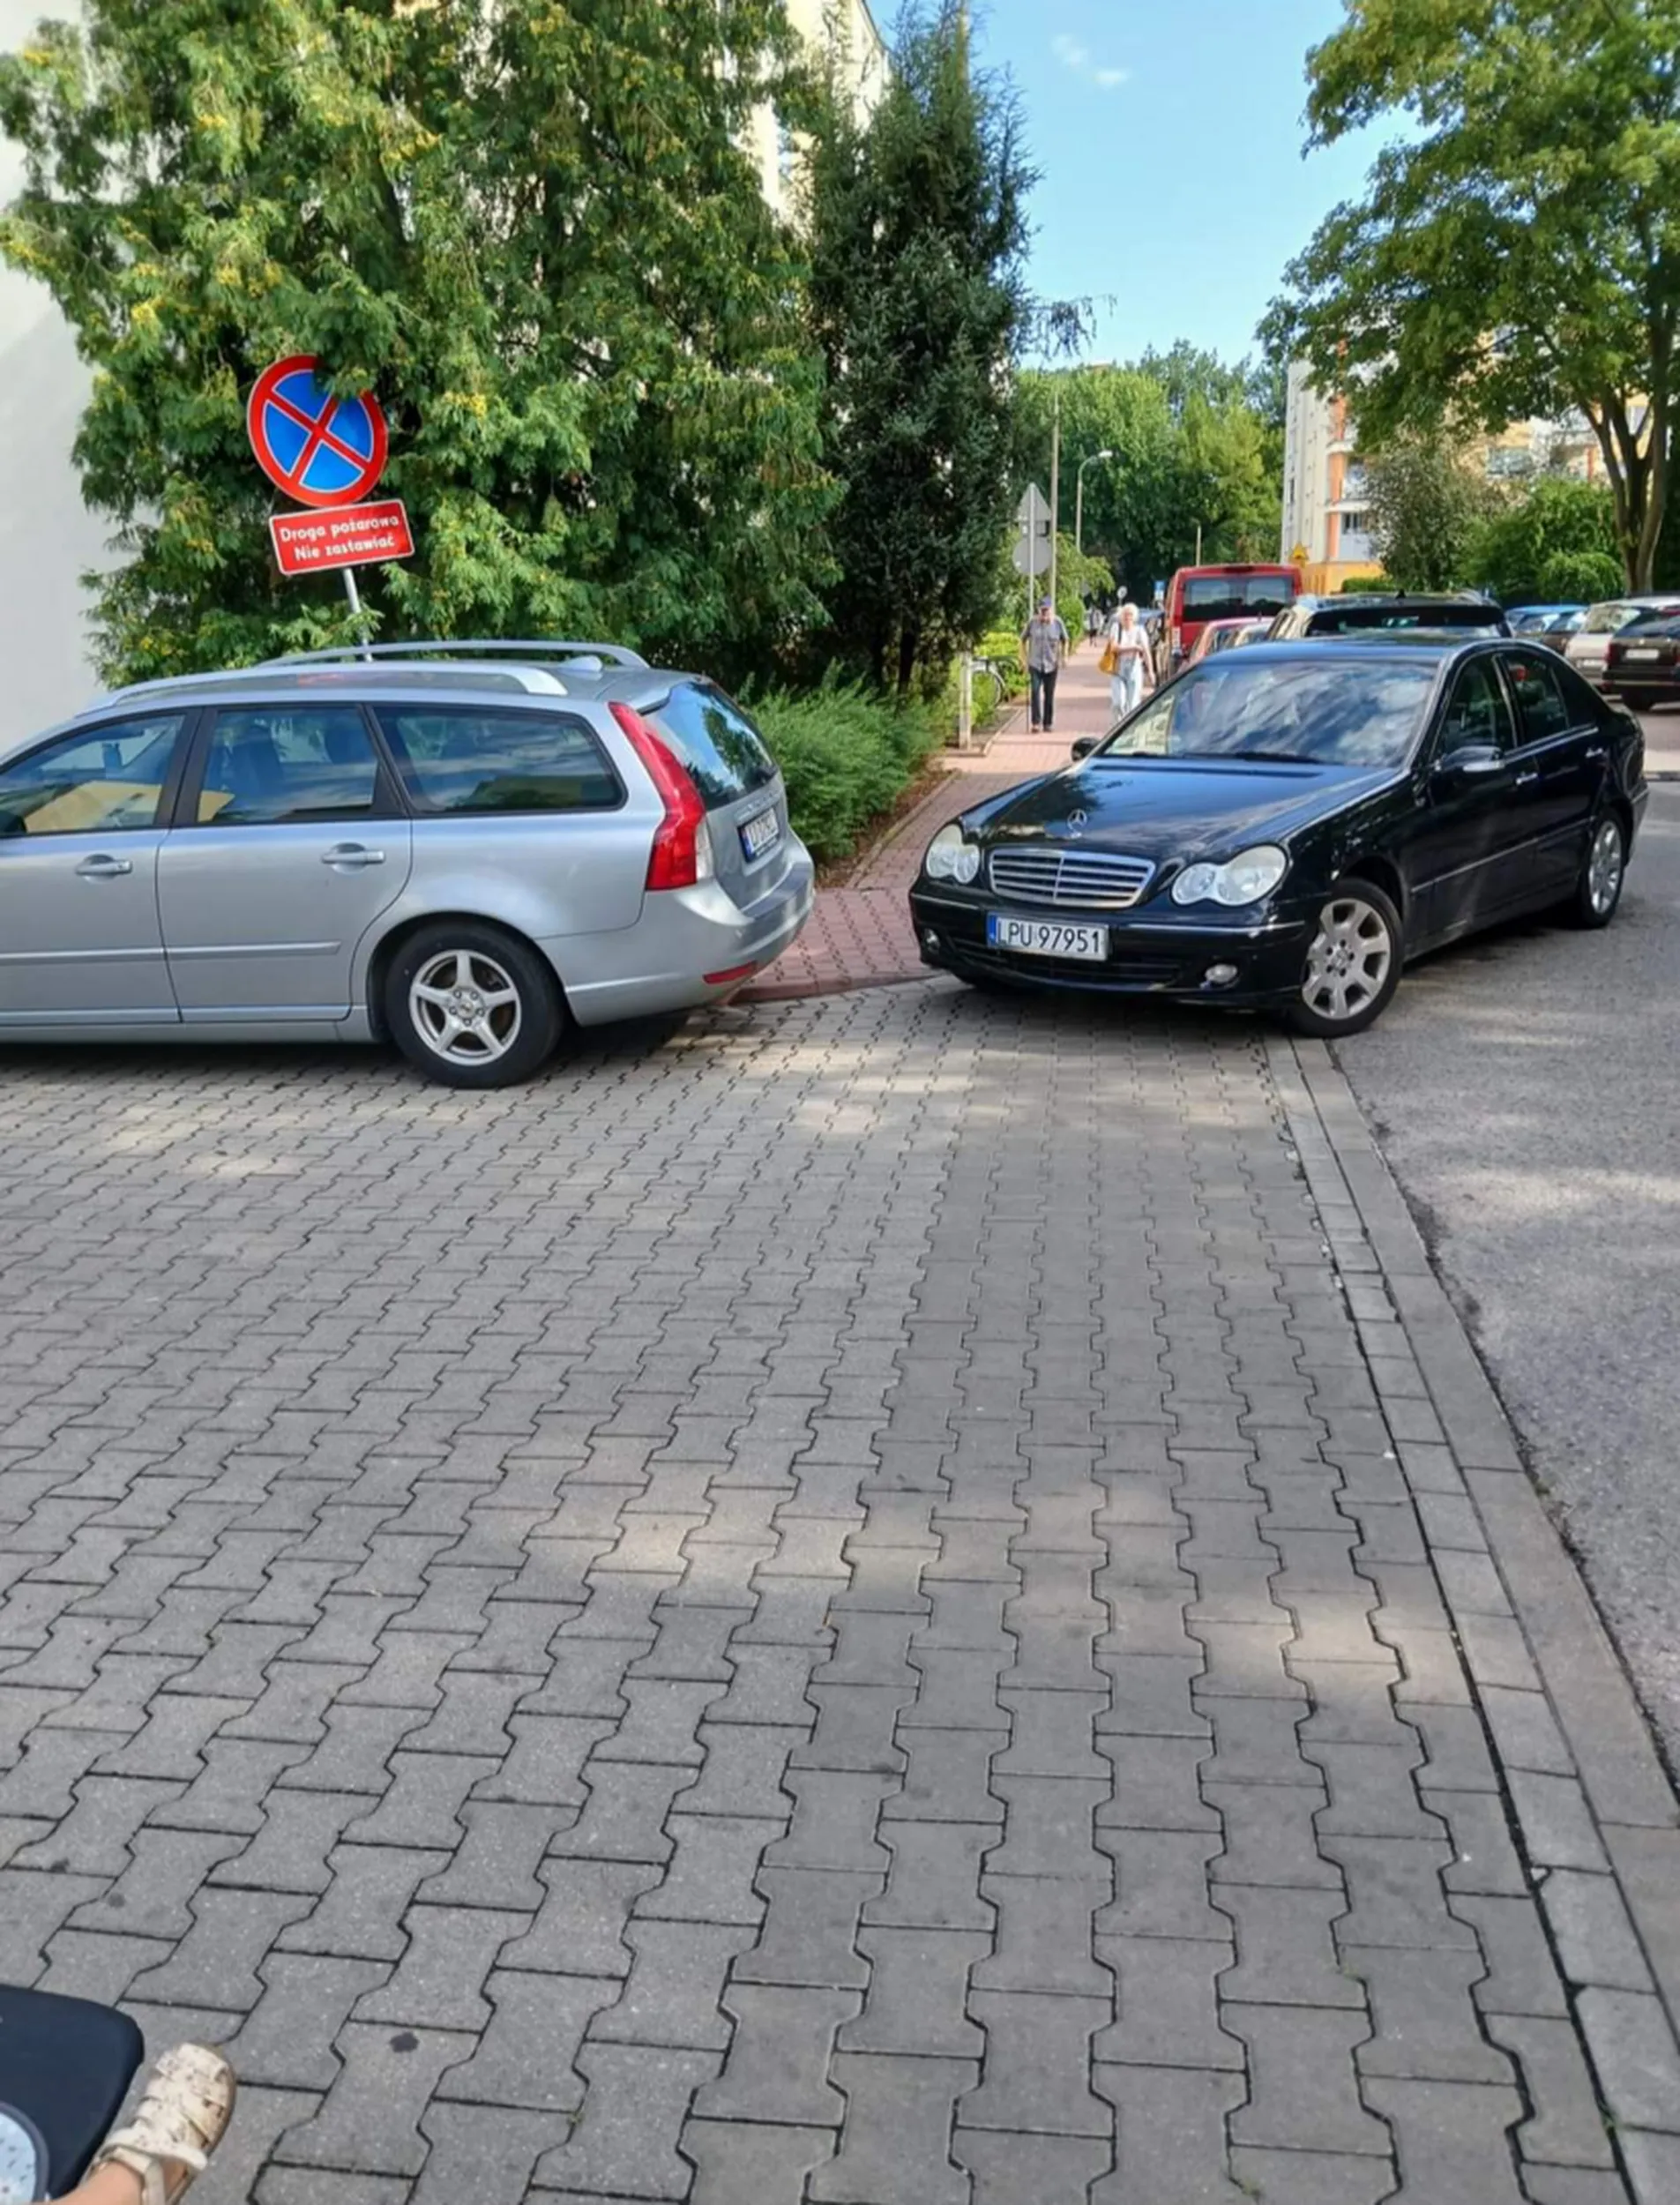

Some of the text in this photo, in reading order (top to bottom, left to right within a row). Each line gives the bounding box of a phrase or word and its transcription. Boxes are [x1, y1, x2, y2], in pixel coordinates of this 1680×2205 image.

[280, 526, 326, 542] Droga
[294, 546, 320, 561] Nie
[997, 920, 1100, 953] LPU 97951
